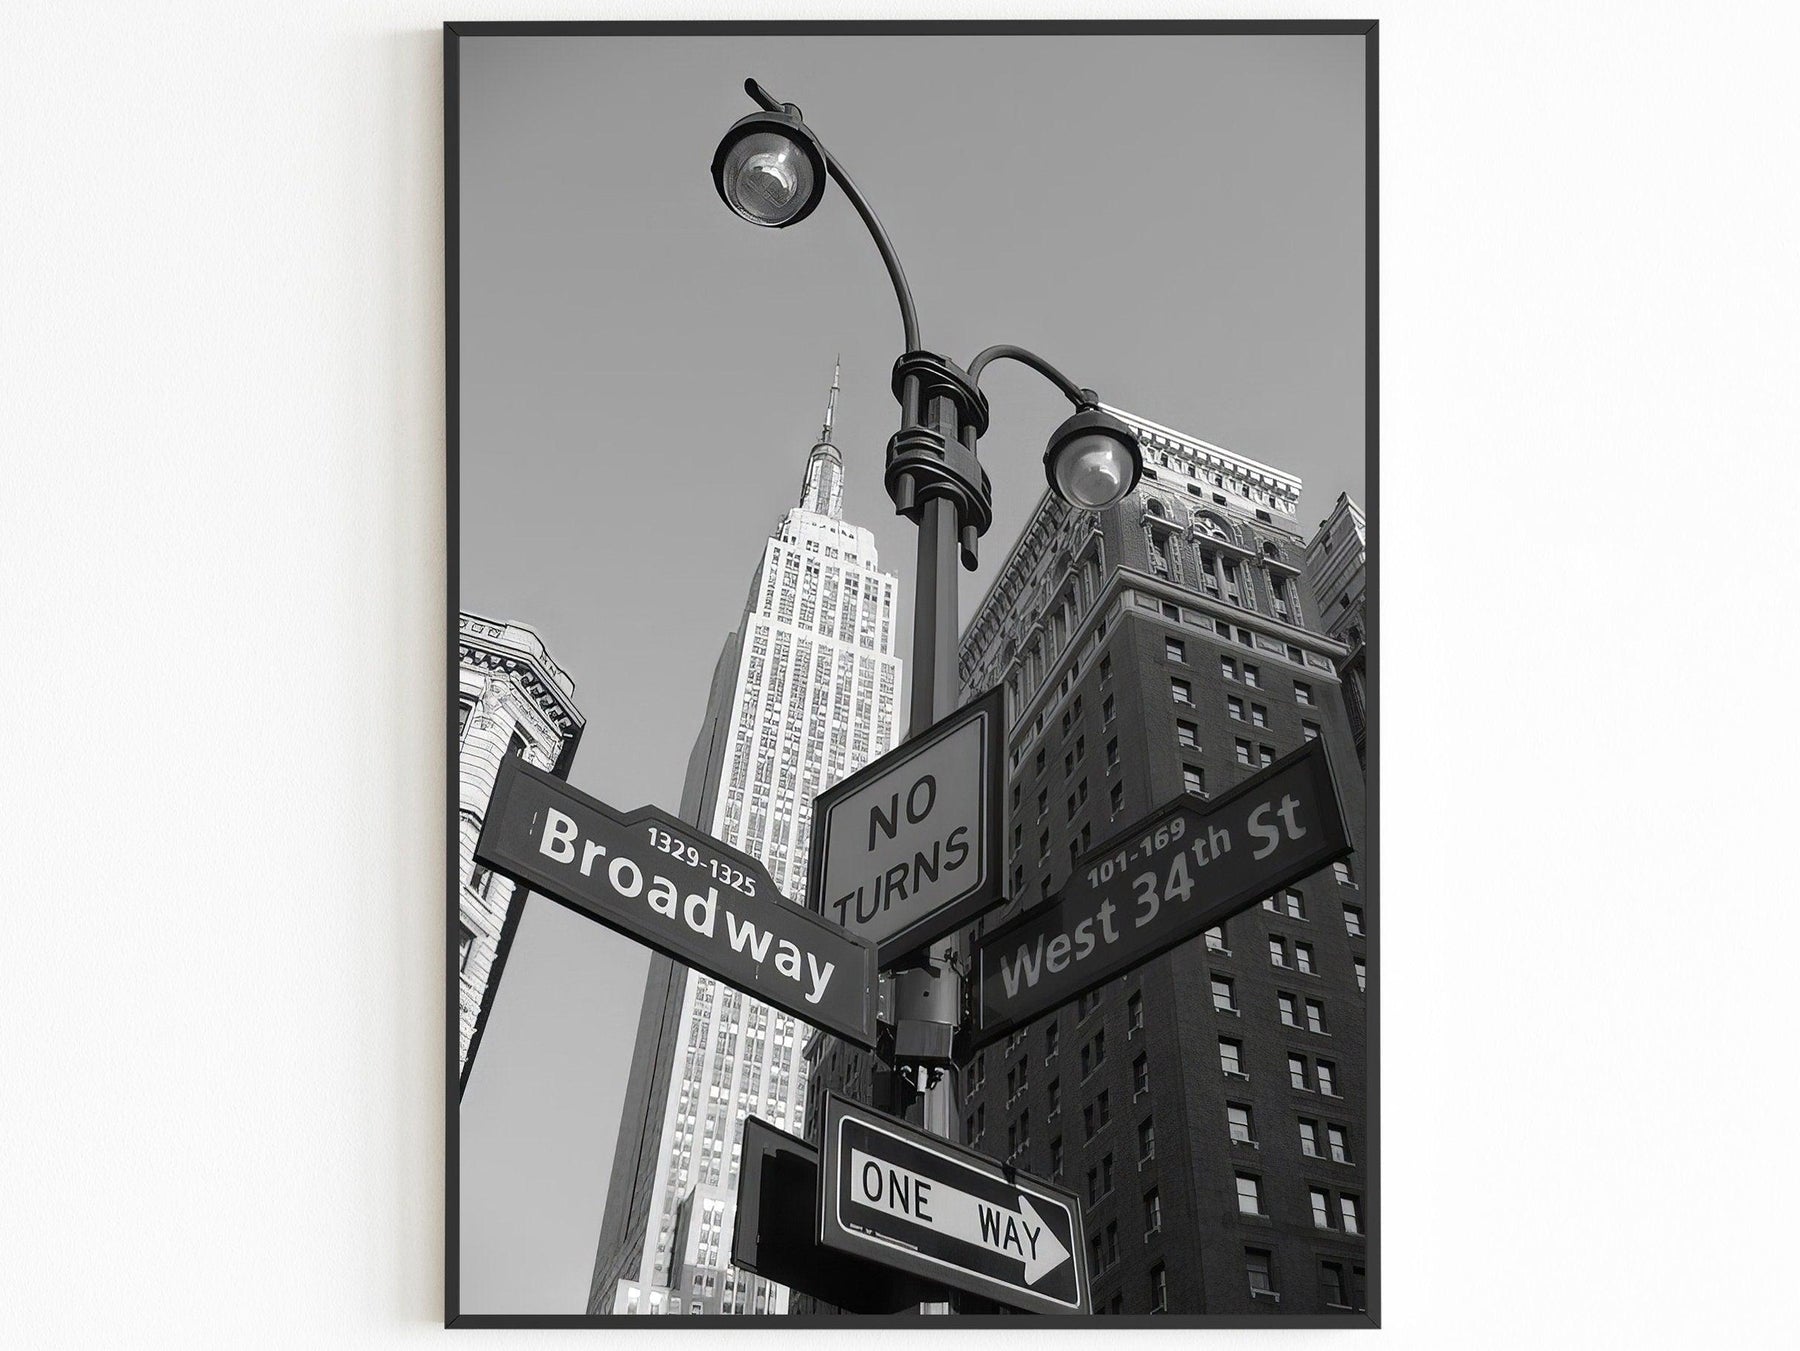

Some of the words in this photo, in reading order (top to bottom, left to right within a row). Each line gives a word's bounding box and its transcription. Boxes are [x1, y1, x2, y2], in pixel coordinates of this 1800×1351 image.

[647, 826, 757, 898] 1329-1325
[868, 774, 937, 852] NO
[1086, 817, 1187, 889] 101-169
[538, 806, 836, 1004] Broadway
[832, 825, 970, 927] TURNS
[1000, 897, 1120, 999] West
[1131, 824, 1232, 929] 34th
[1247, 793, 1307, 862] St
[862, 1160, 933, 1223] ONE
[977, 1203, 1042, 1261] WAY
